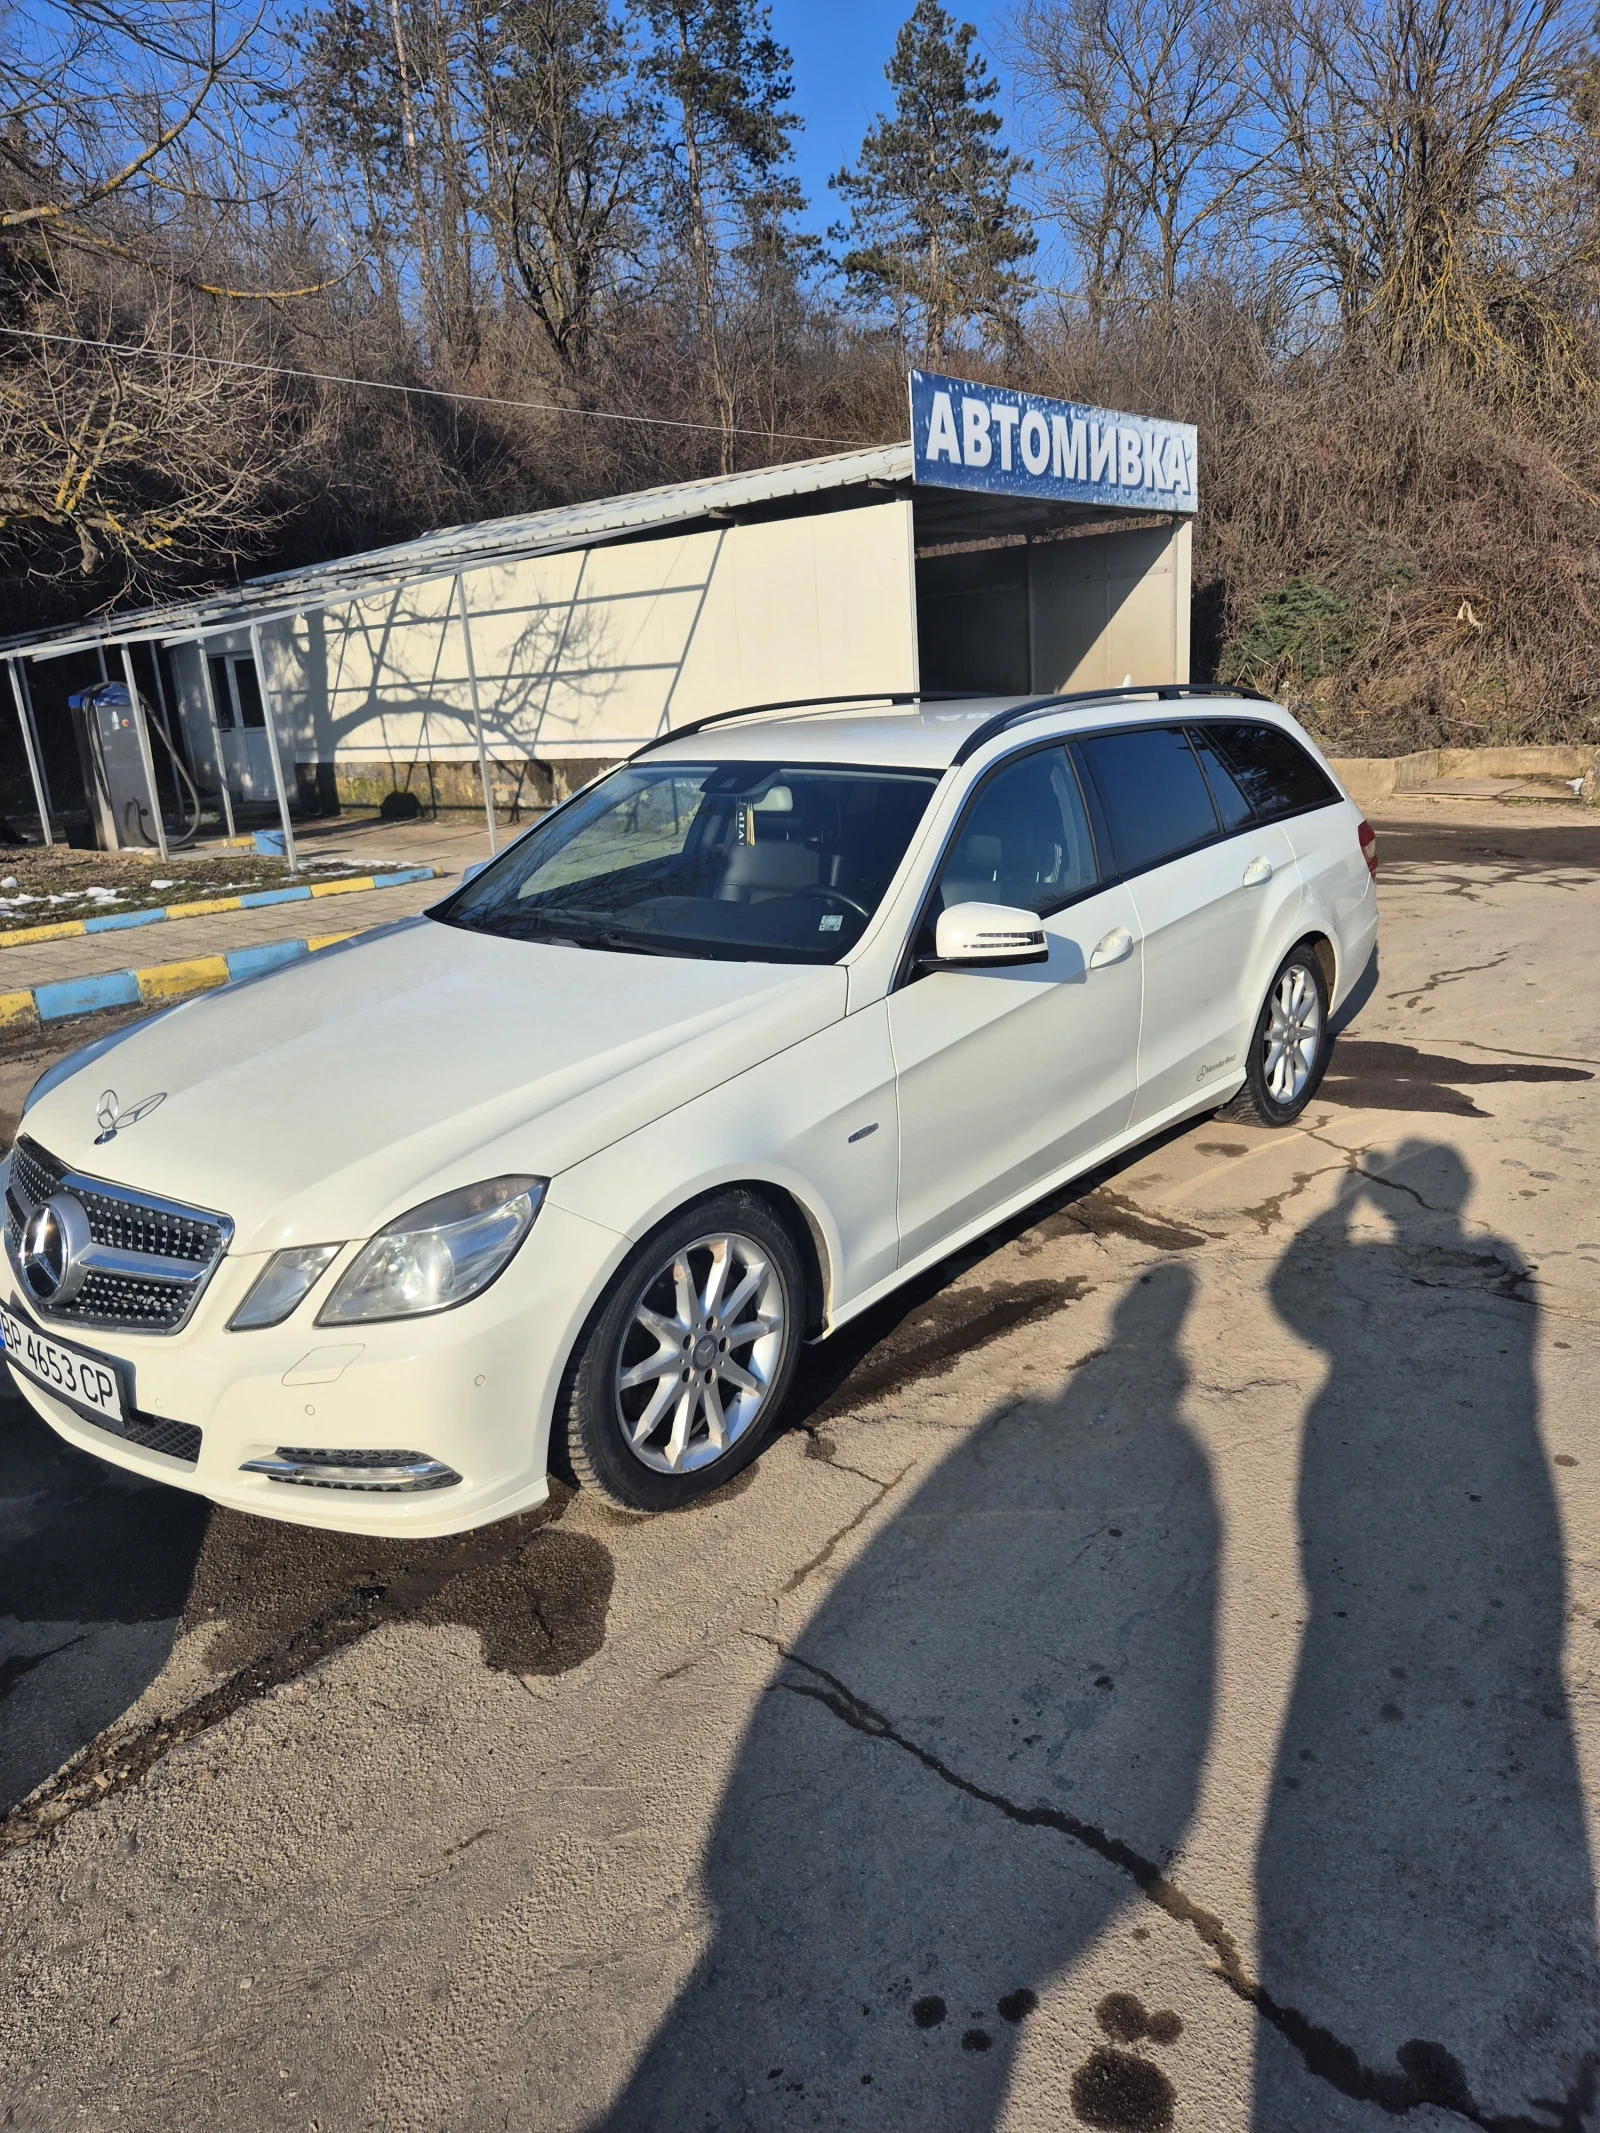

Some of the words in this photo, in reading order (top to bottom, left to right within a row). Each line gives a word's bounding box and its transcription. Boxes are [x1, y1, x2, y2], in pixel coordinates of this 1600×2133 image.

[926, 391, 1191, 495] АВТОМИВКА
[27, 1334, 77, 1392] 4653
[80, 1363, 113, 1408] CP
